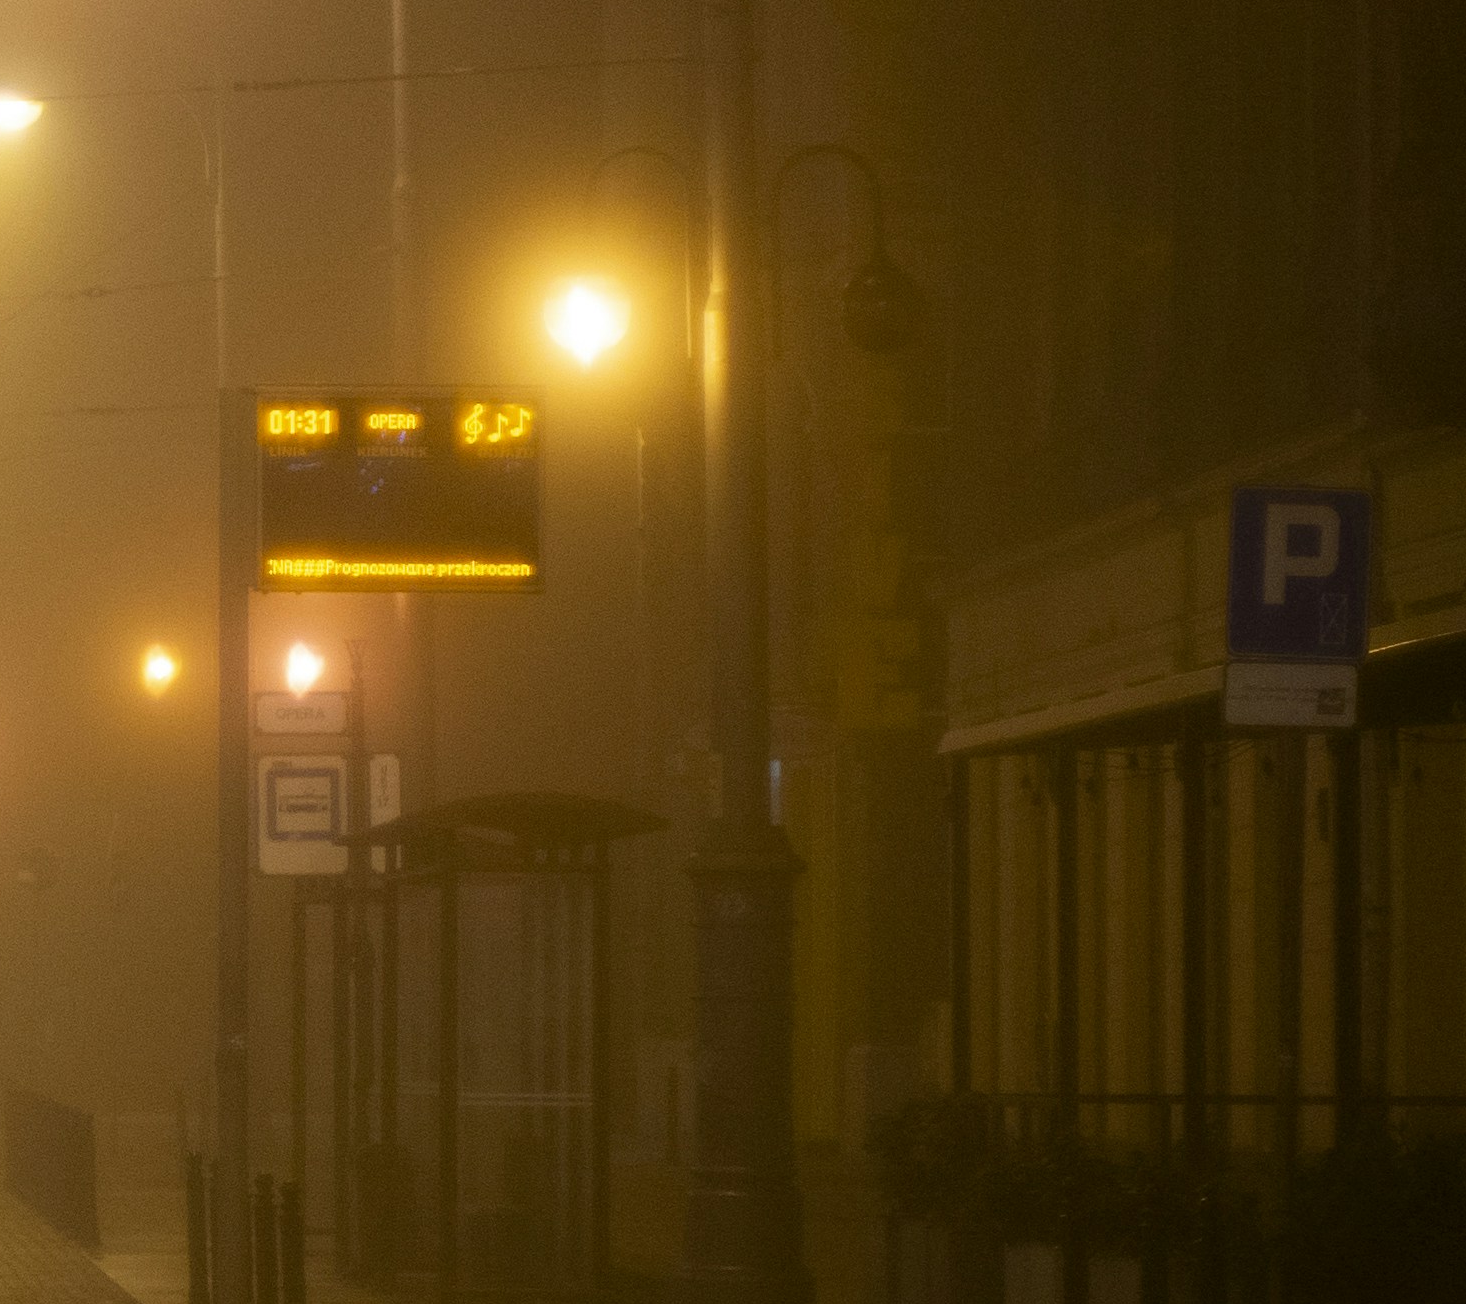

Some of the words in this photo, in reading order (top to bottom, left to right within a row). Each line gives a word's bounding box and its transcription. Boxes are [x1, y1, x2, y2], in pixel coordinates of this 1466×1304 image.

[269, 409, 331, 435] 01:31
[369, 413, 417, 430] OPERA
[1261, 502, 1342, 606] P
[275, 707, 326, 721] OPERA
